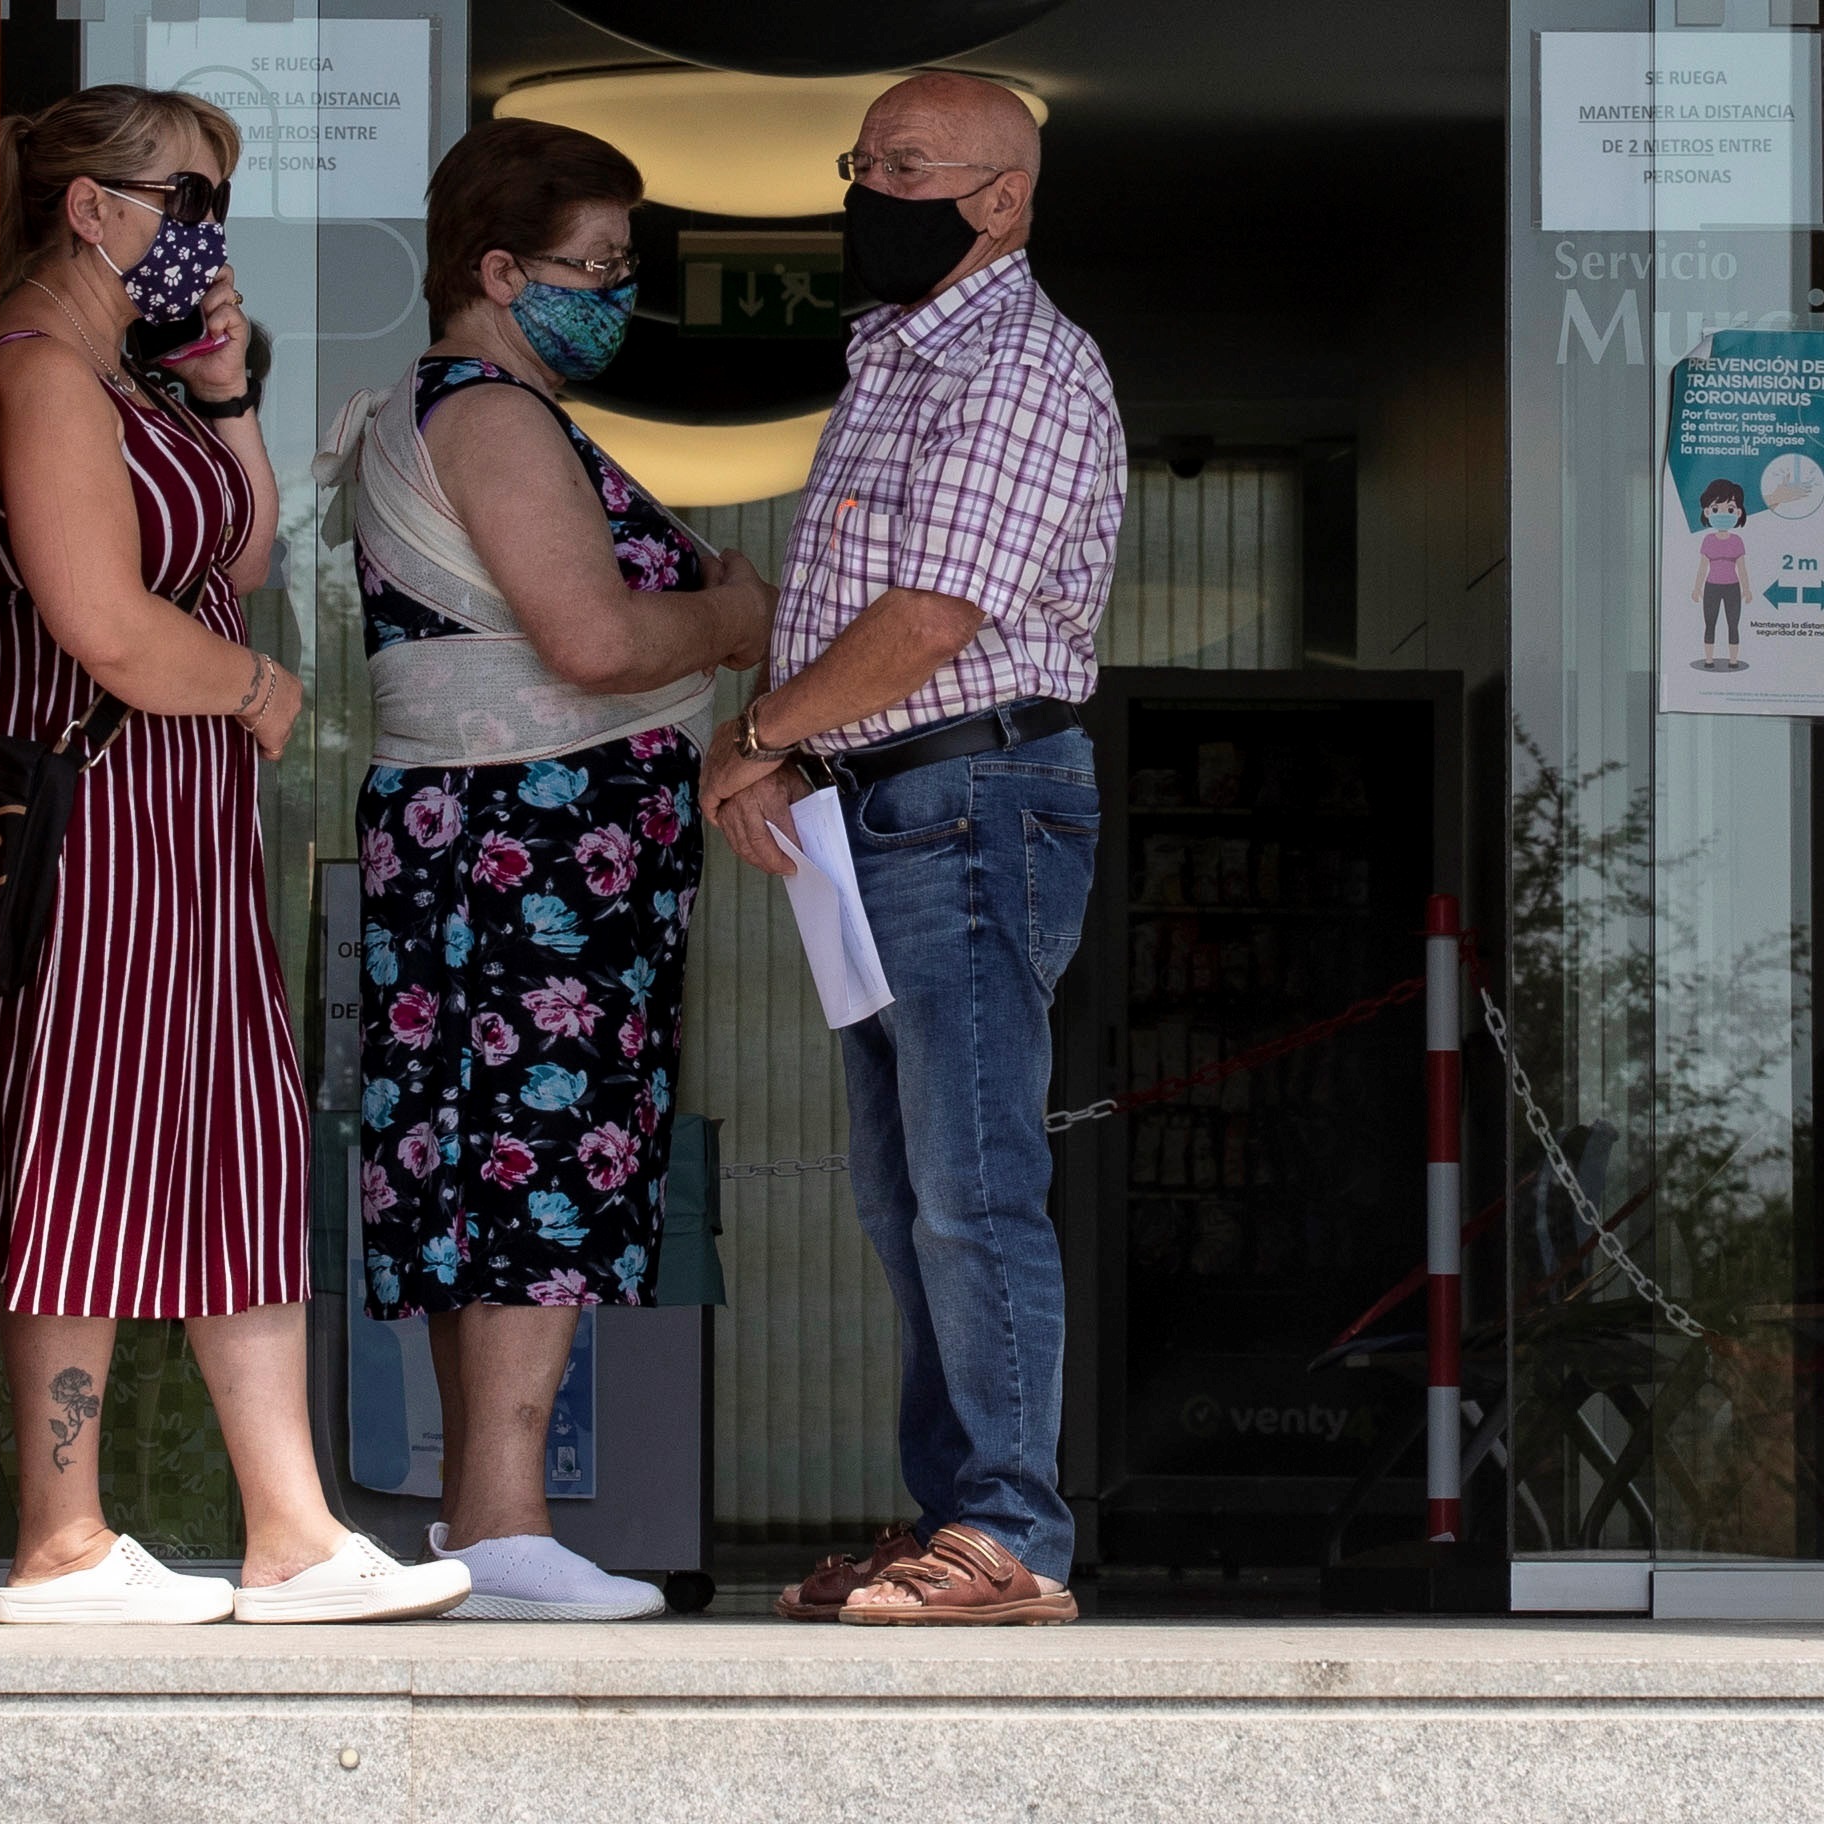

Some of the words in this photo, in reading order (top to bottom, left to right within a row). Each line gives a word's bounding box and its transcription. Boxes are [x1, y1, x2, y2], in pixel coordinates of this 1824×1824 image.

[251, 57, 271, 72] SE
[275, 57, 334, 72] RUEGA
[1644, 71, 1664, 85] SE
[1670, 71, 1727, 85] RUEGA
[285, 92, 306, 106] LA
[311, 91, 401, 107] DISTANCIA
[1579, 105, 1675, 121] MANTENER
[1680, 104, 1700, 119] LA
[1705, 104, 1795, 119] DISTANCIA
[248, 126, 320, 140] METROS
[325, 126, 378, 141] ENTRE
[1602, 139, 1624, 154] DE
[1628, 139, 1638, 153] 2
[1643, 139, 1714, 153] METROS
[1719, 138, 1773, 153] ENTRE
[1643, 169, 1732, 184] PERSONAS
[1555, 240, 1737, 280] Servicio
[1688, 355, 1798, 373] PREVENCIÓN
[1687, 373, 1805, 390] TRANSMISIÓN
[1684, 390, 1812, 406] CORONAVIRUS
[1681, 409, 1703, 420] Por
[1704, 409, 1739, 422] favor,
[1741, 411, 1777, 421] antes
[1681, 420, 1697, 431] de
[1698, 422, 1739, 434] entrar,
[1742, 422, 1774, 435] haga
[1776, 423, 1821, 436] higiene
[1681, 432, 1696, 443] de
[1698, 434, 1741, 444] manos
[1743, 436, 1750, 447] y
[1753, 432, 1805, 447] póngase
[1680, 444, 1692, 455] la
[1694, 444, 1760, 456] mascarilla
[1782, 554, 1794, 570] 2
[1798, 558, 1818, 571] m
[1750, 620, 1791, 630] Mantenga
[1791, 621, 1799, 629] la
[1756, 628, 1796, 637] seguridad
[1796, 629, 1807, 637] de
[1808, 629, 1814, 637] 2
